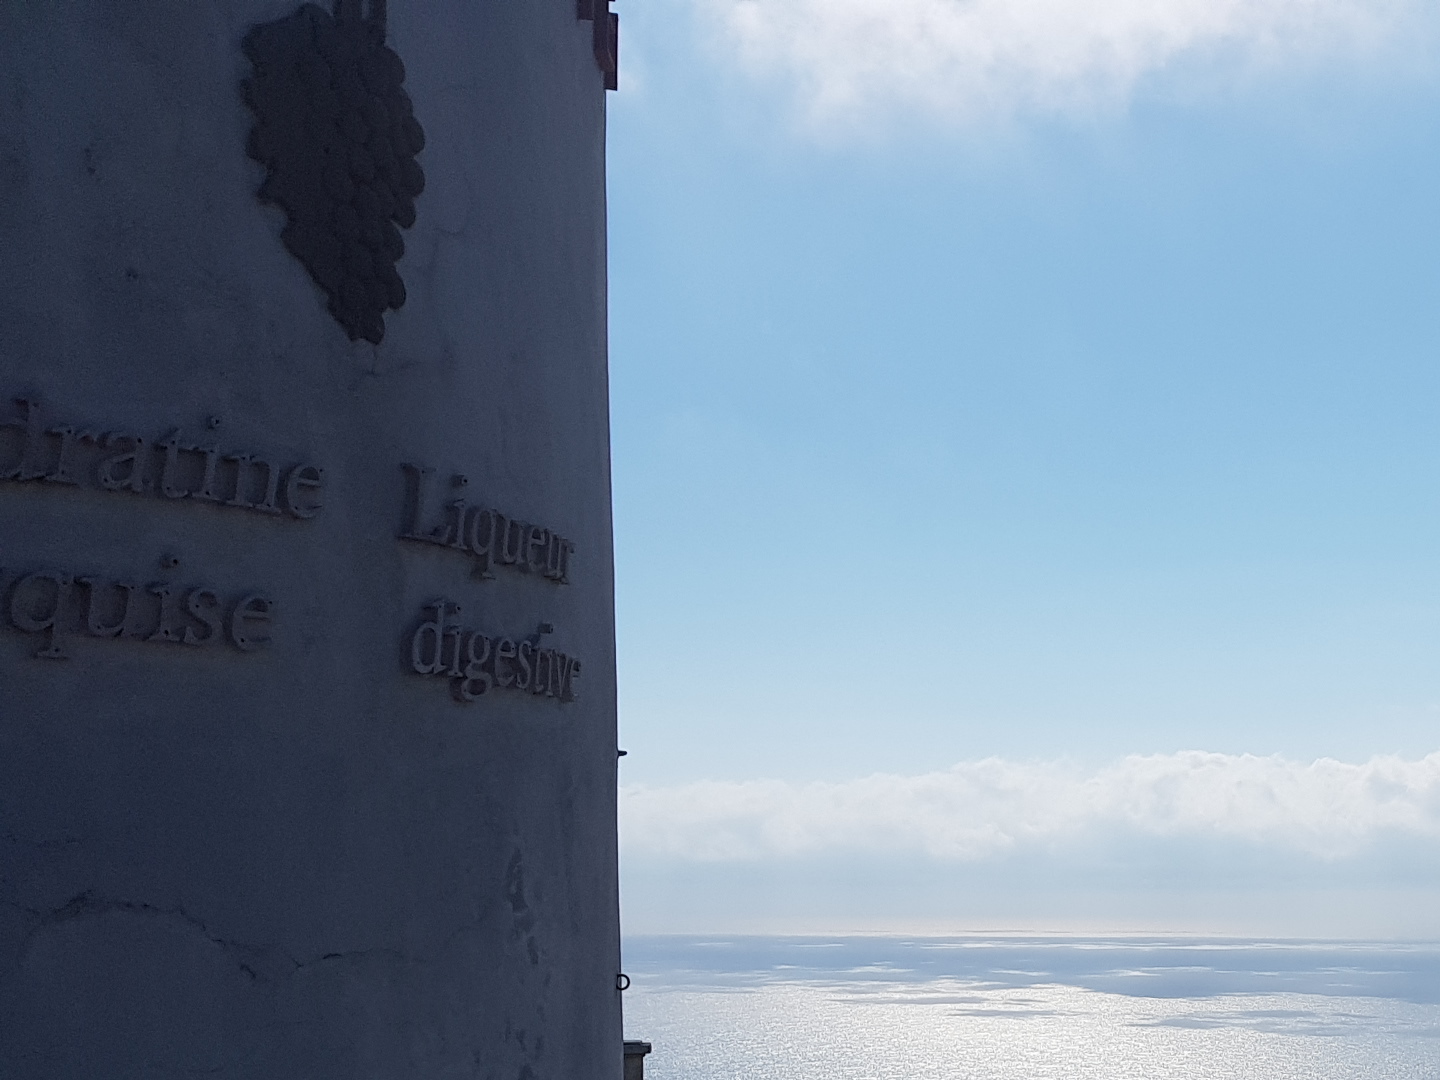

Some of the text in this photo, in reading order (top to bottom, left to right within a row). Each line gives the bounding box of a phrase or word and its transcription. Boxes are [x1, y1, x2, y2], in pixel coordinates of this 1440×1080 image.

[396, 462, 576, 585] Liqueur
[8, 557, 273, 659] quise
[408, 598, 582, 702] digestive
